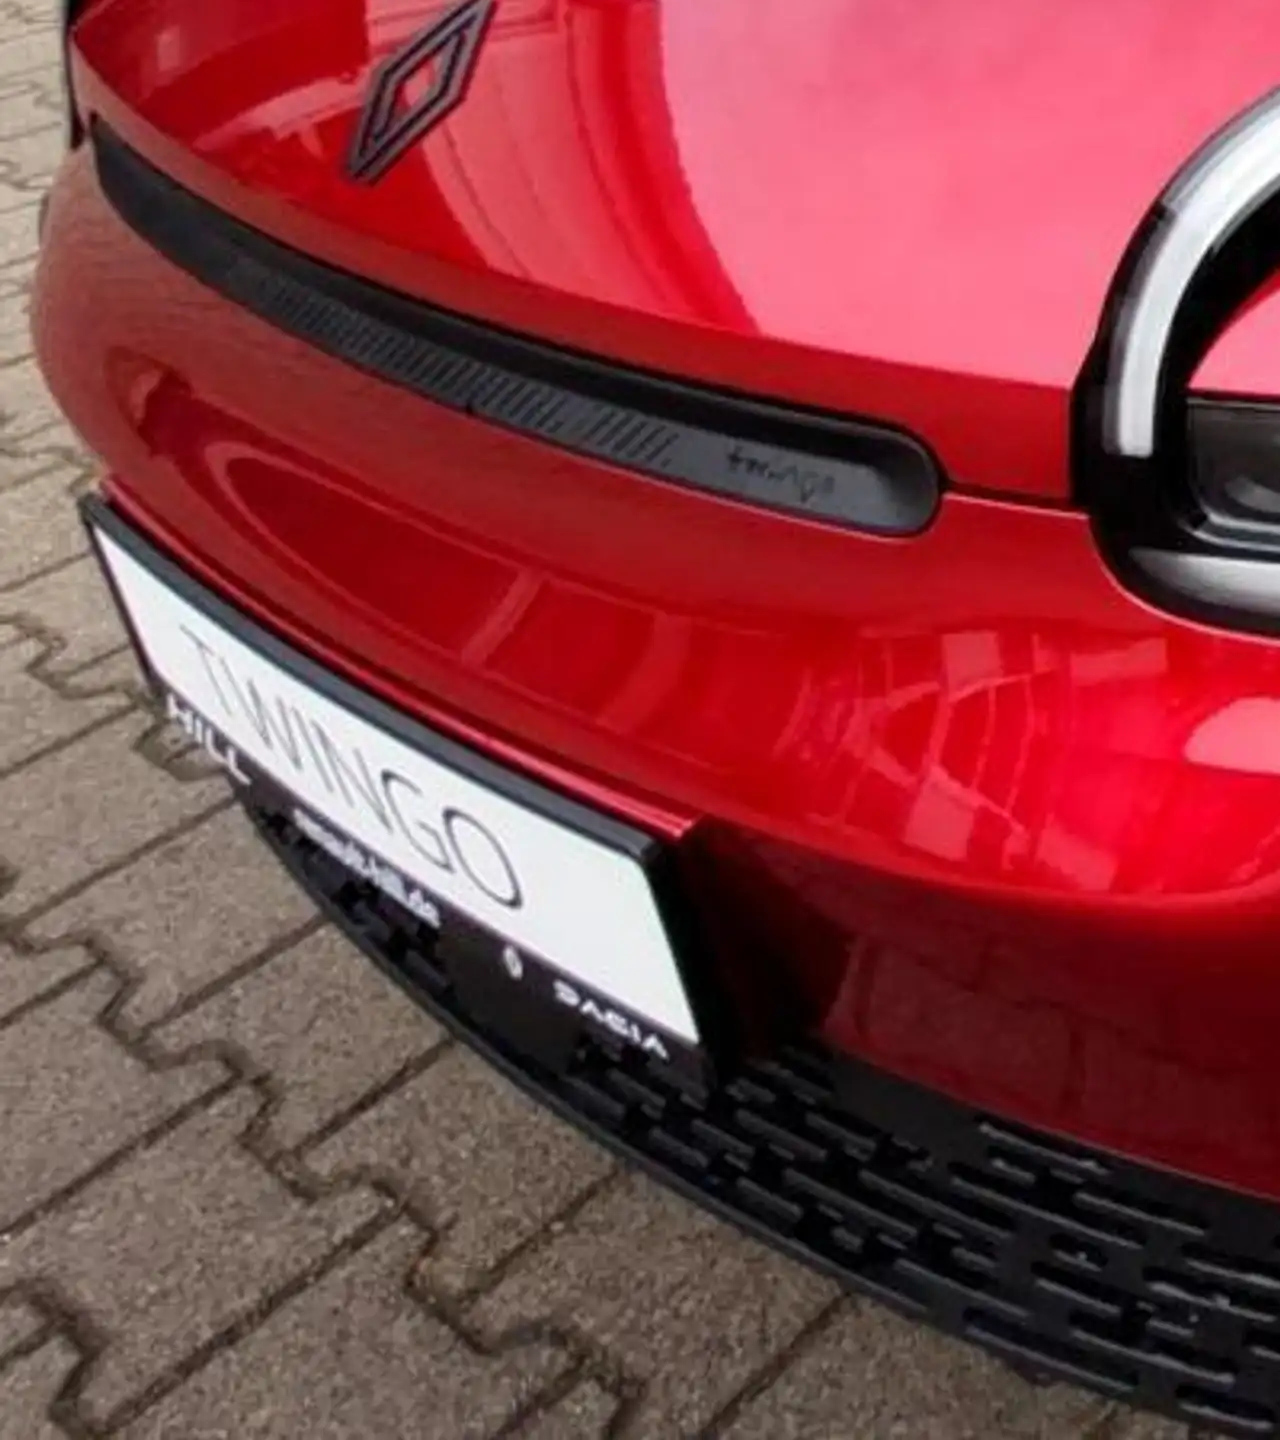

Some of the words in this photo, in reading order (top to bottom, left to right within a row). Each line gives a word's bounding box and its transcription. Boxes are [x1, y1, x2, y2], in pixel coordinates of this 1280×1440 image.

[167, 692, 252, 786] HILL
[179, 624, 523, 910] TWINGO
[553, 979, 670, 1060] DACIA
